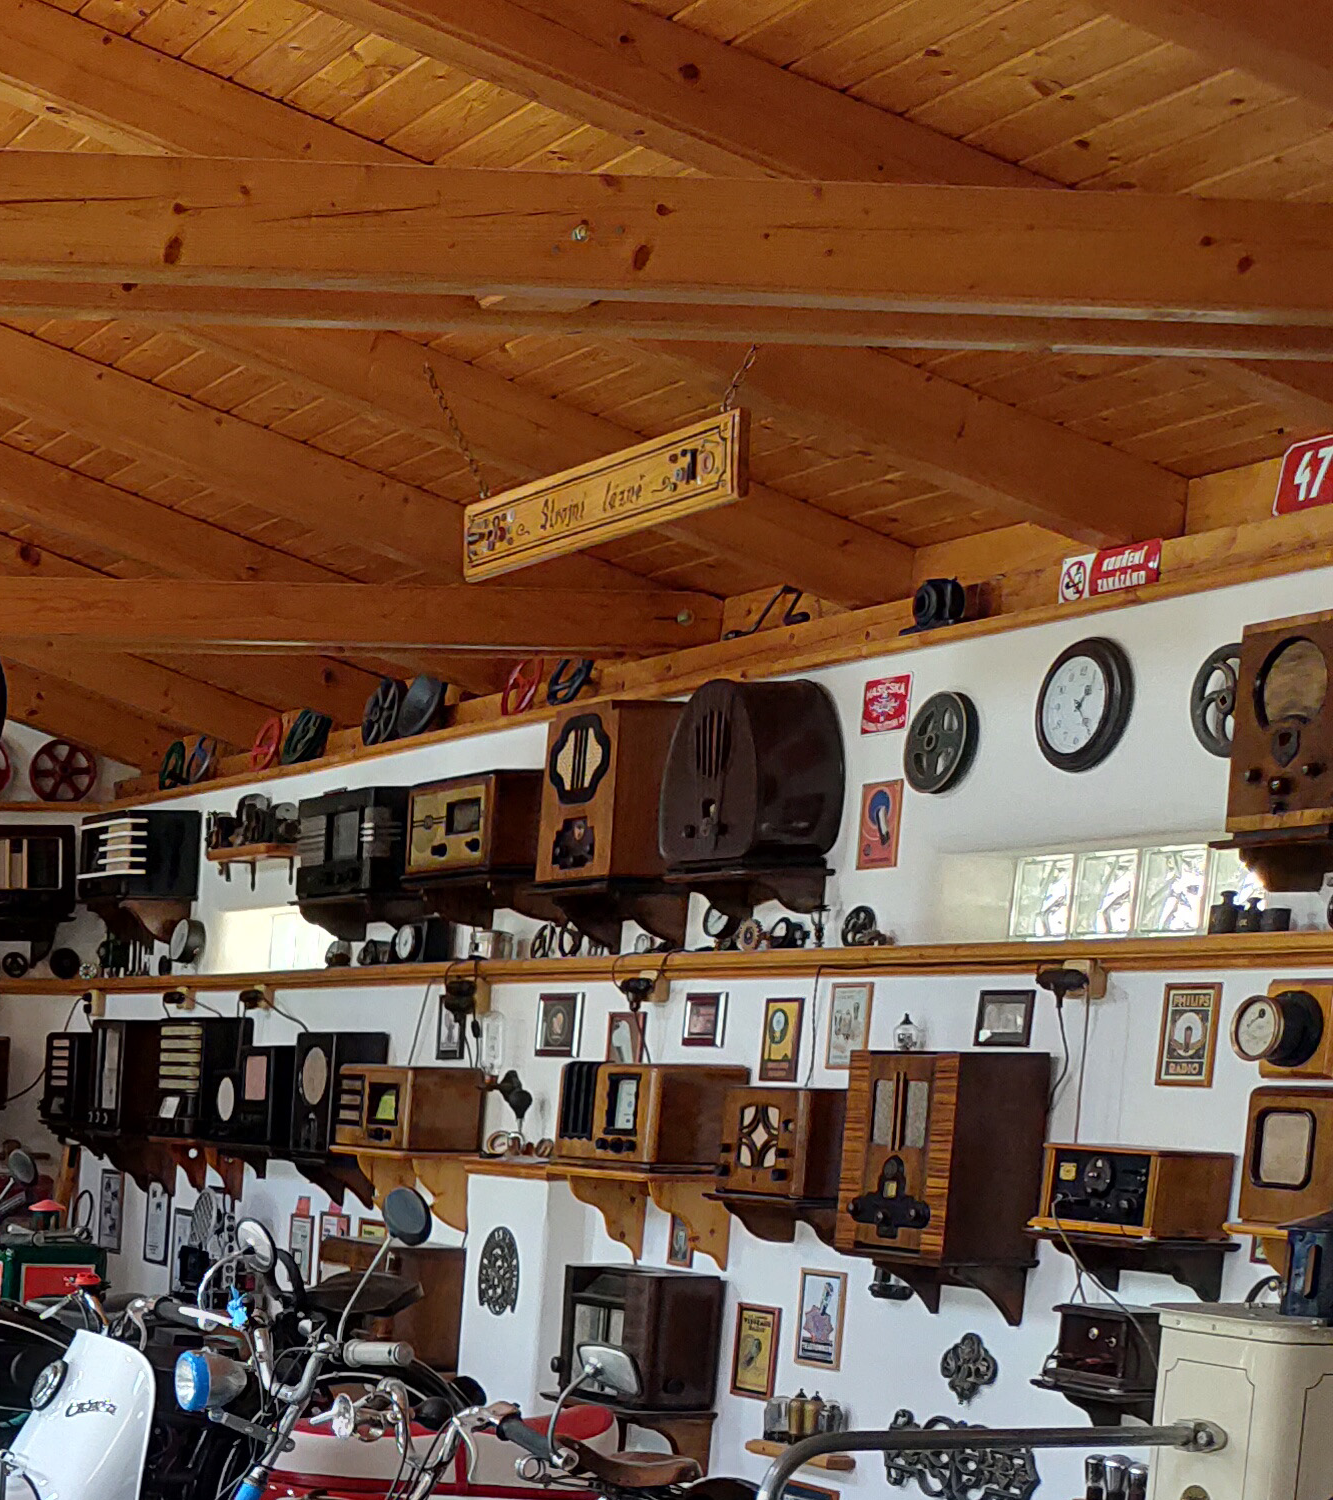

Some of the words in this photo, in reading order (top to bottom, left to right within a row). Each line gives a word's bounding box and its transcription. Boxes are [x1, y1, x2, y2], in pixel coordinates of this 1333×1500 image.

[1294, 444, 1333, 502] 47
[1173, 994, 1211, 1007] PHILIPS
[1168, 1062, 1200, 1074] RADIO
